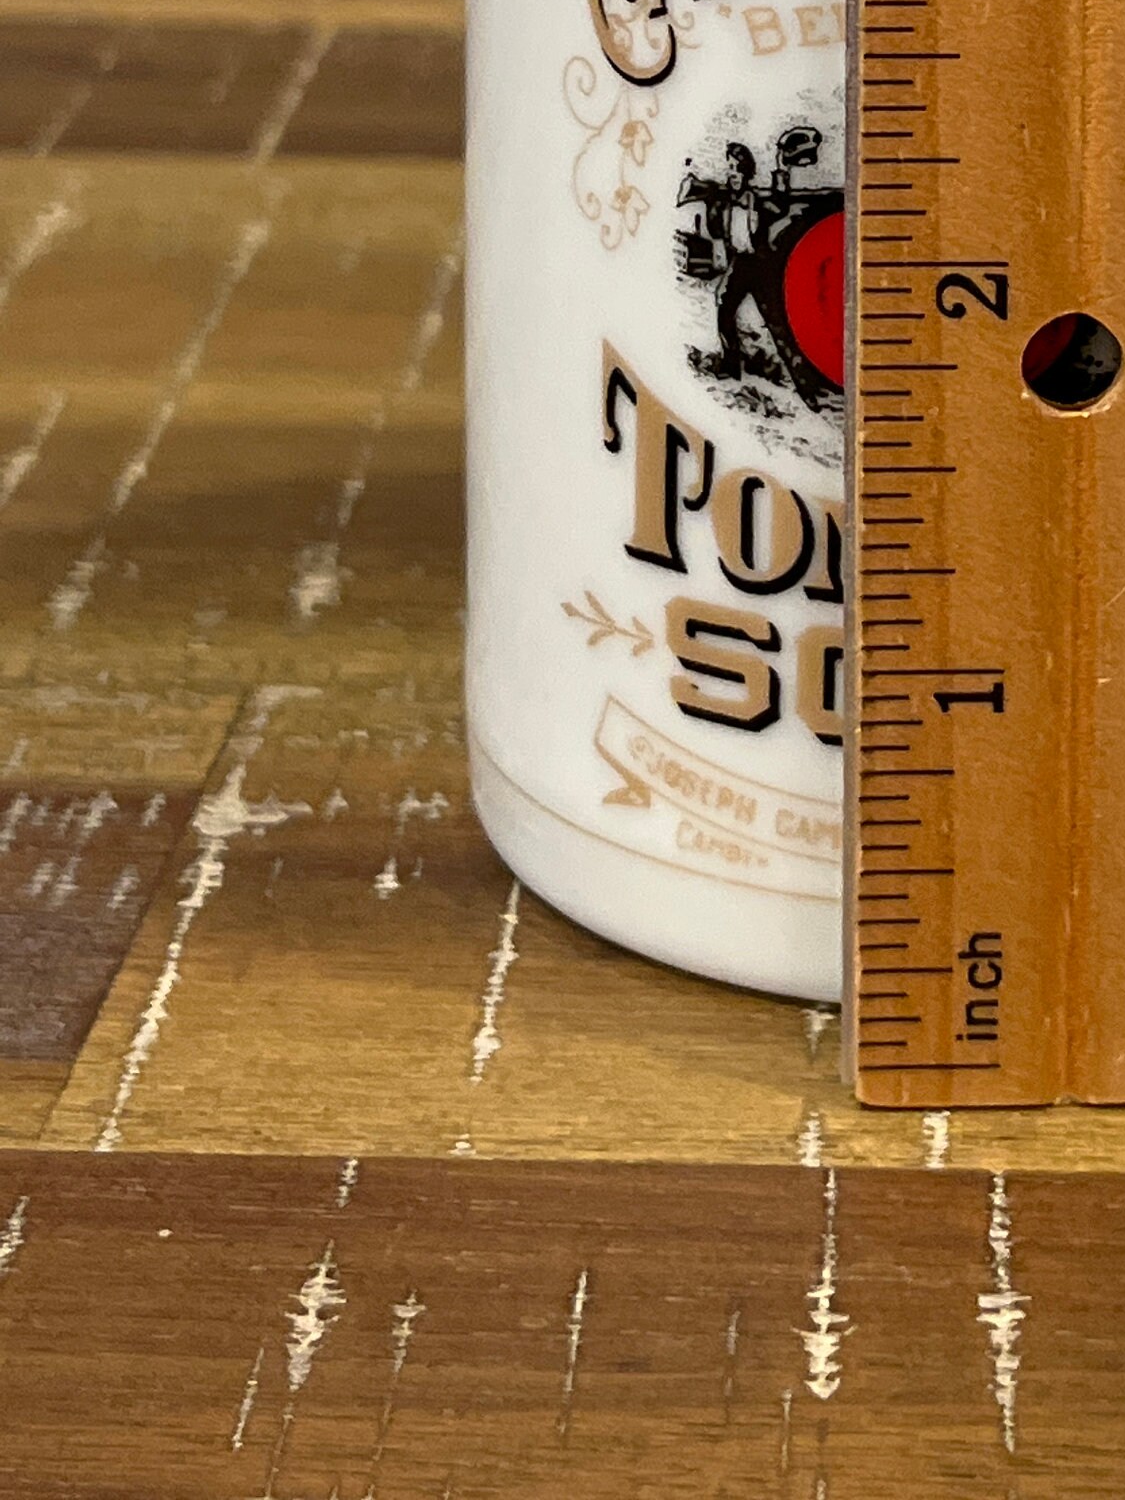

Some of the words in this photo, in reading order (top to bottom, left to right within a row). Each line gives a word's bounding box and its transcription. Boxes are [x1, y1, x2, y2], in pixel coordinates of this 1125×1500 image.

[936, 272, 1009, 320] 2
[933, 681, 1005, 714] 1
[956, 931, 1003, 1041] inch
